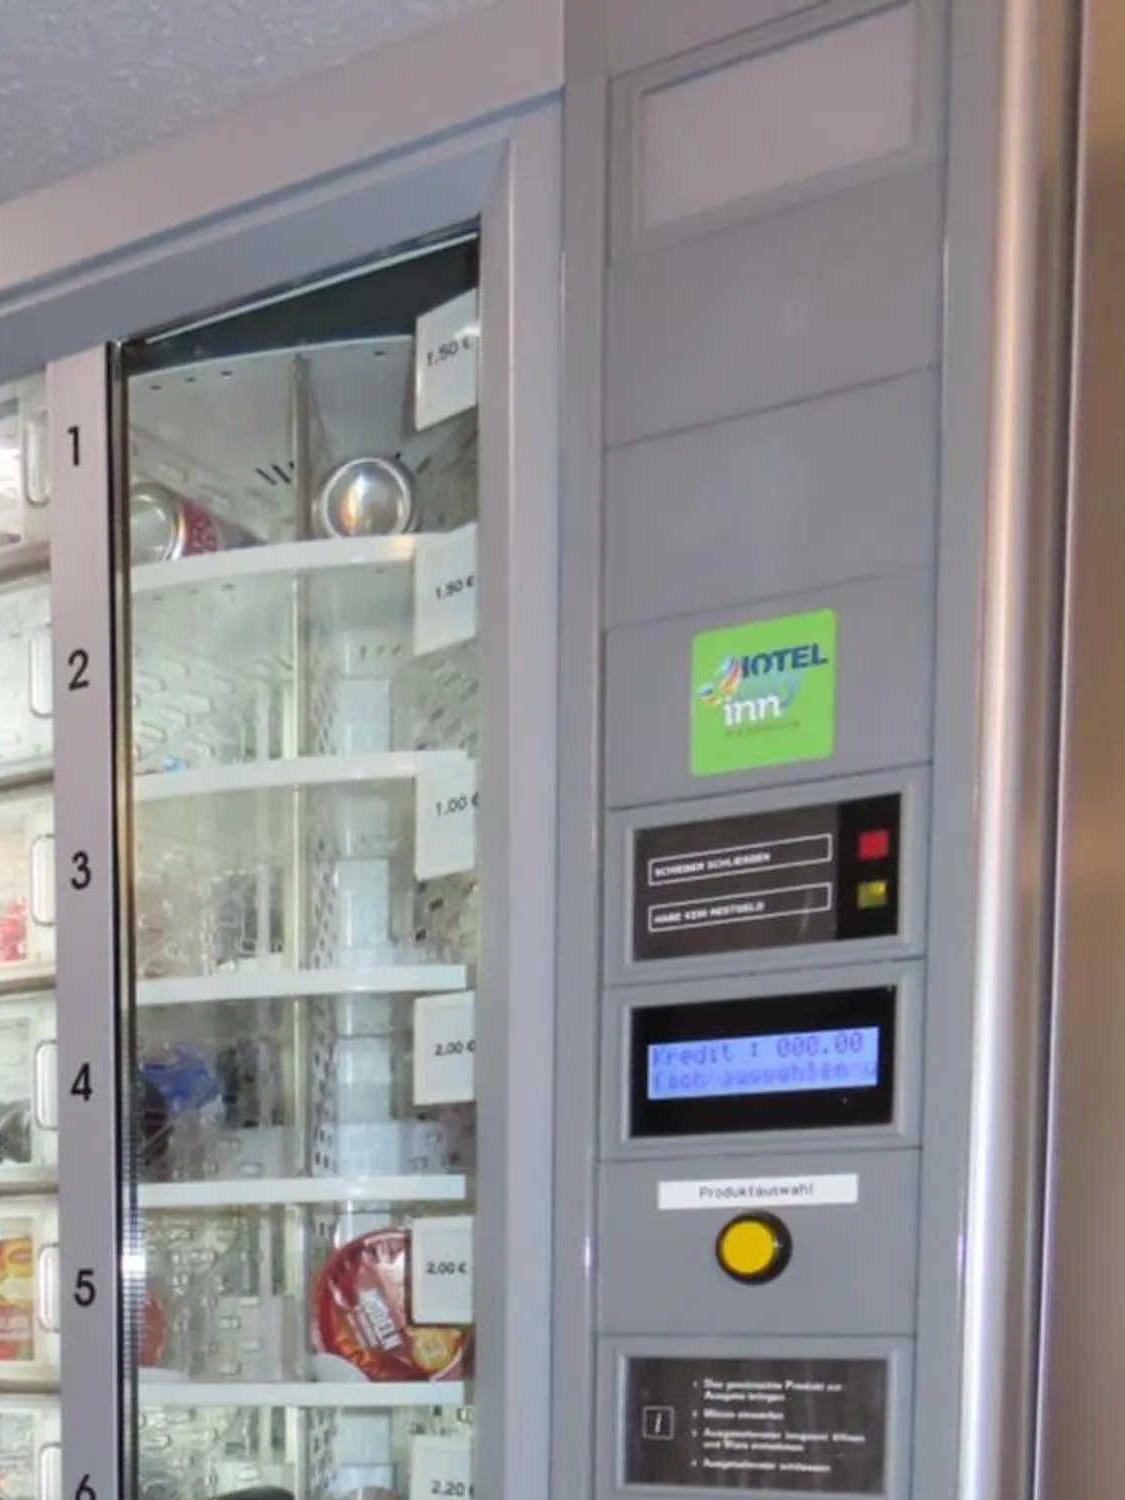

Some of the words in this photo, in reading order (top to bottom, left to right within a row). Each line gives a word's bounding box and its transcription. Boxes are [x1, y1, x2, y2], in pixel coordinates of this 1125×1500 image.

[67, 425, 81, 466] 1
[67, 648, 90, 691] 2
[723, 695, 781, 726] inn
[436, 797, 468, 818] 1.00
[70, 850, 92, 892] 3
[434, 1041, 464, 1058] 2.00
[652, 1041, 735, 1068] Kredit
[776, 1031, 864, 1059] 000.00
[70, 1062, 93, 1102] 4
[699, 1183, 814, 1200] Produktauswahl
[73, 1268, 97, 1309] 5
[431, 1479, 466, 1498] 2.20
